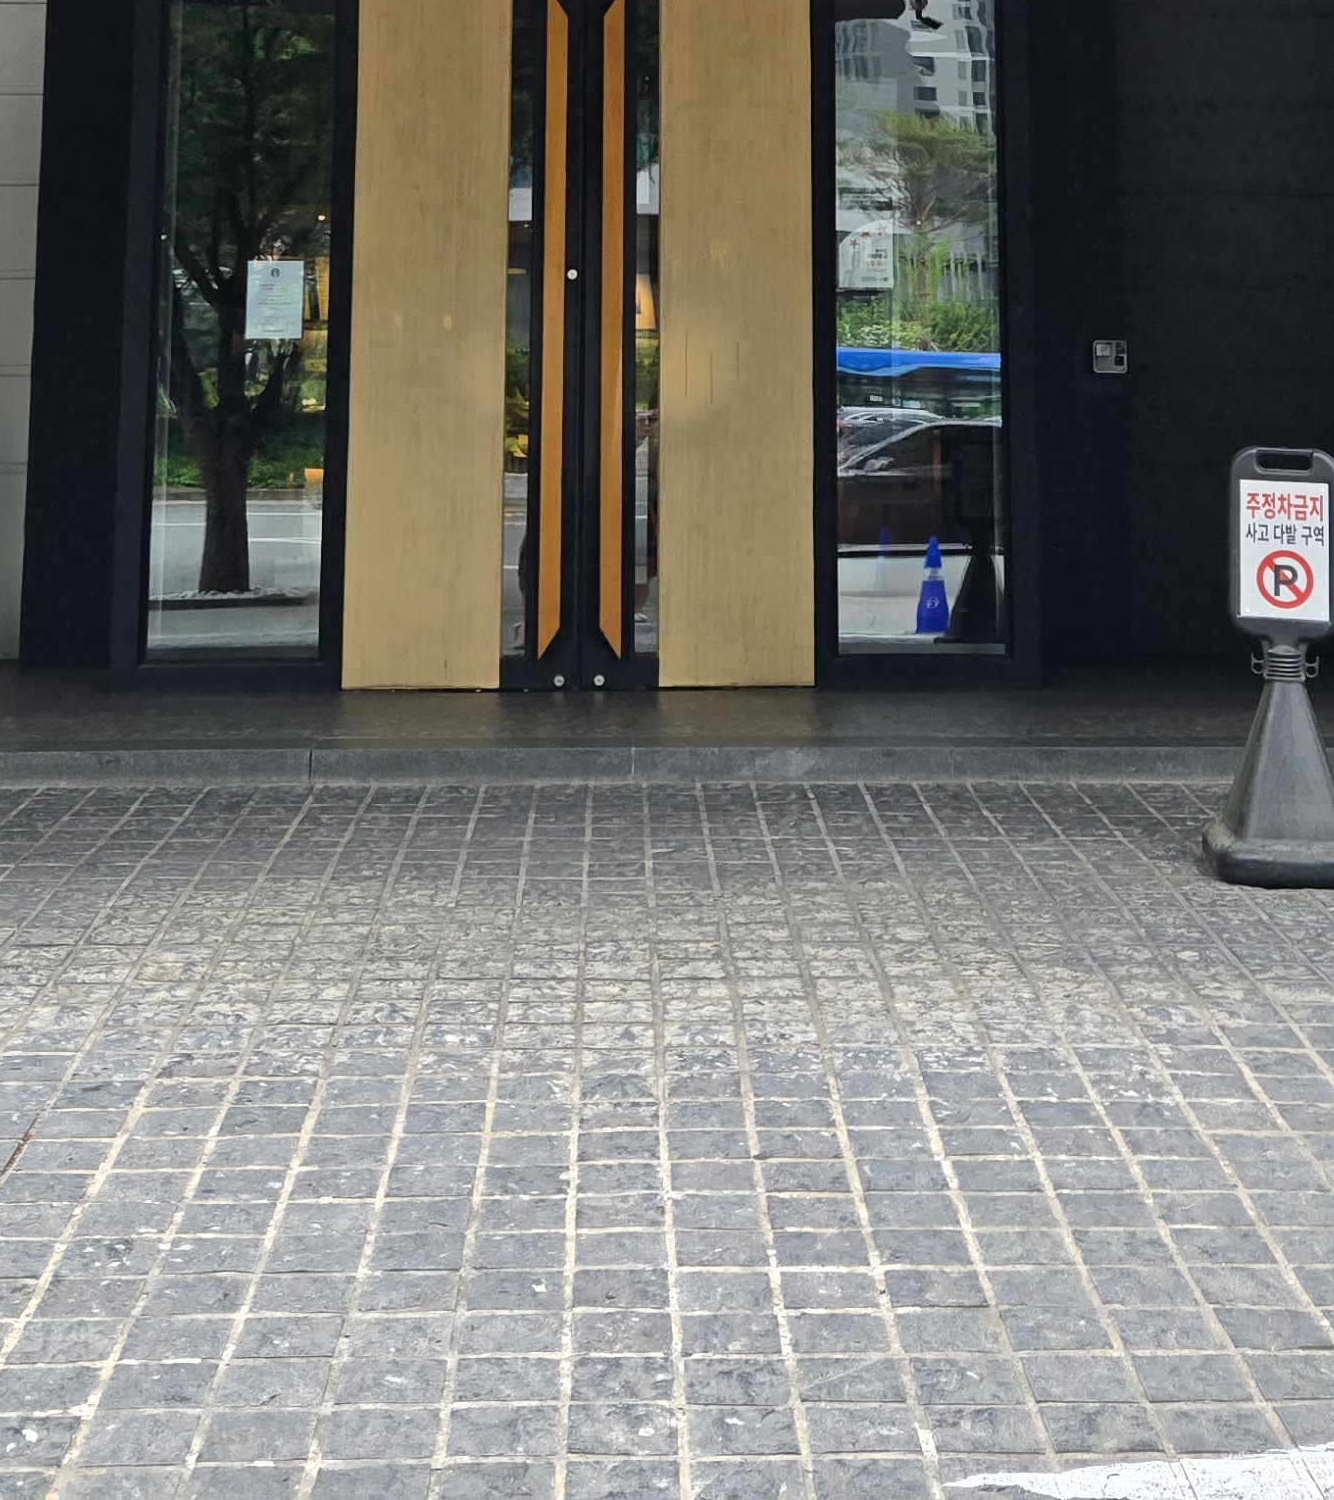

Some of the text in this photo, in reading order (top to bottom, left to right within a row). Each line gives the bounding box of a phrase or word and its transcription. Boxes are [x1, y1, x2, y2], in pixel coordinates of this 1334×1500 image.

[1246, 492, 1324, 522] 주정차금지
[1245, 523, 1325, 546] 사고 다발 구역
[1273, 563, 1298, 597] P
